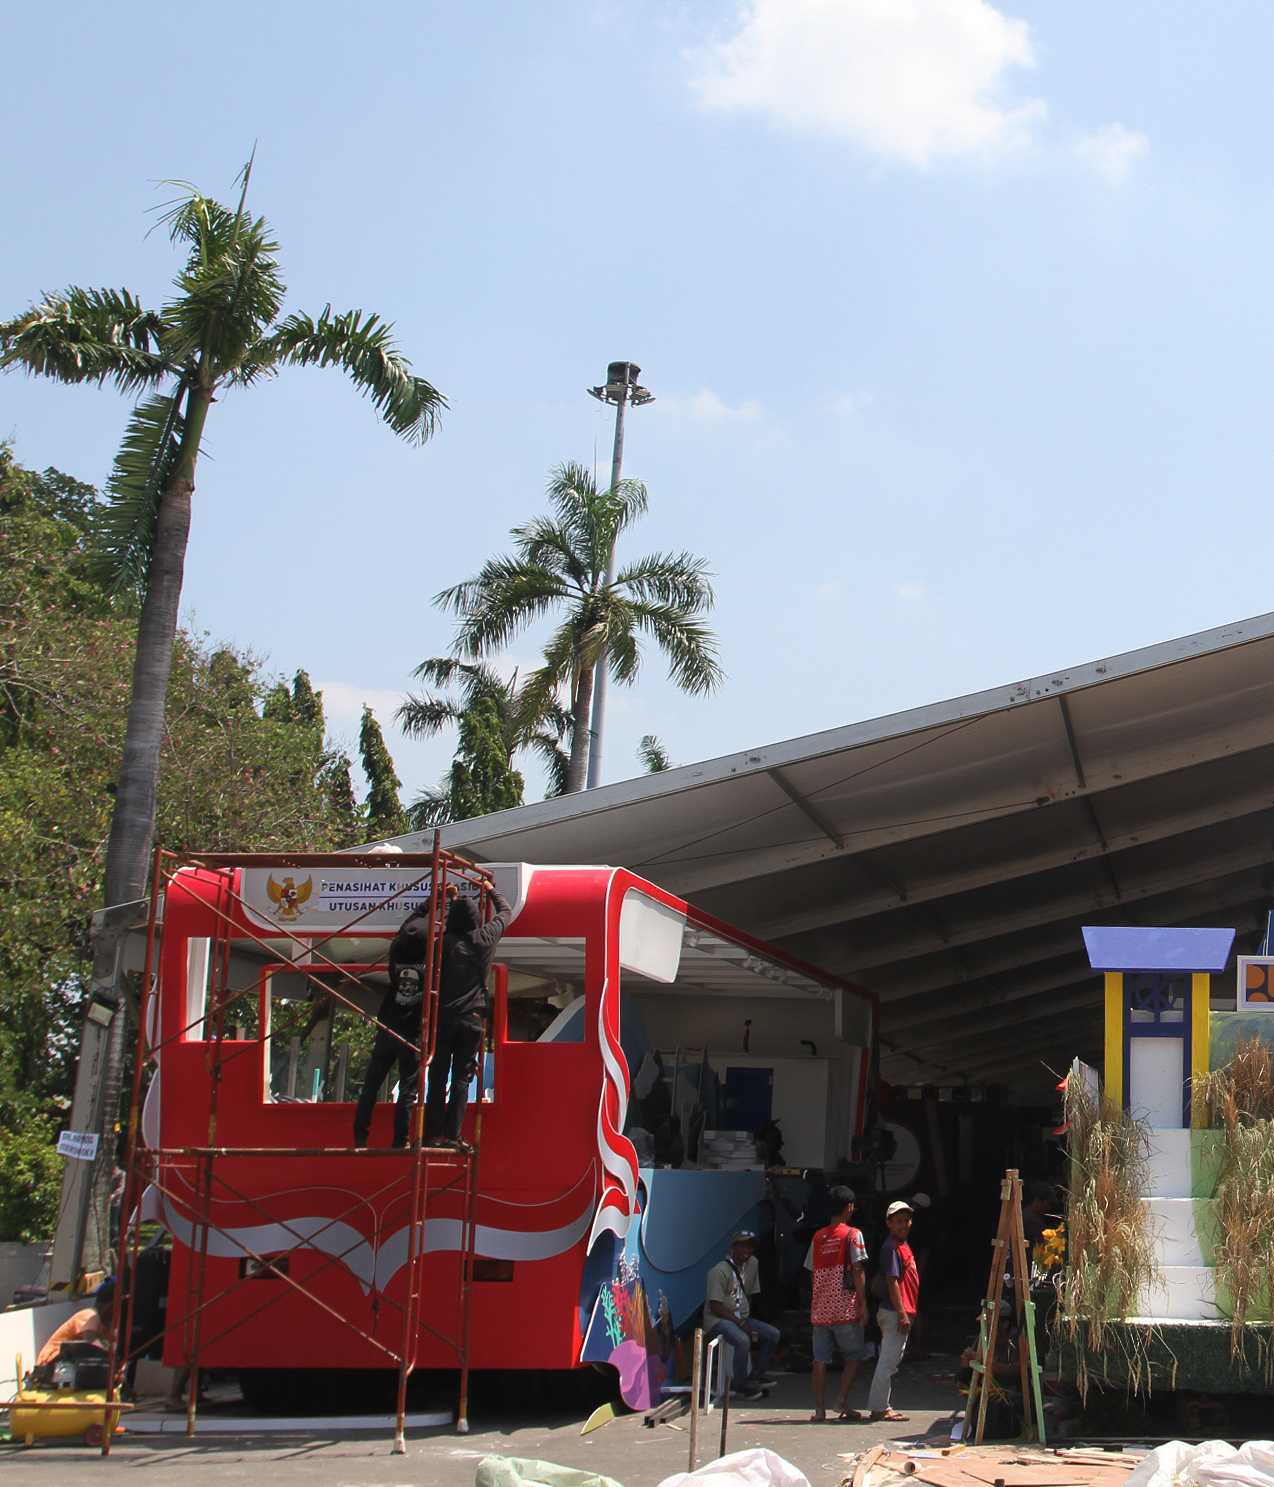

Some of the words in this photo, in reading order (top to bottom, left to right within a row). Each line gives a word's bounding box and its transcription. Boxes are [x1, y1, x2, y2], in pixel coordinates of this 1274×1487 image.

[321, 882, 386, 892] PENASIHAT
[329, 902, 379, 911] UTUSAN
[380, 902, 420, 911] KHUSU
